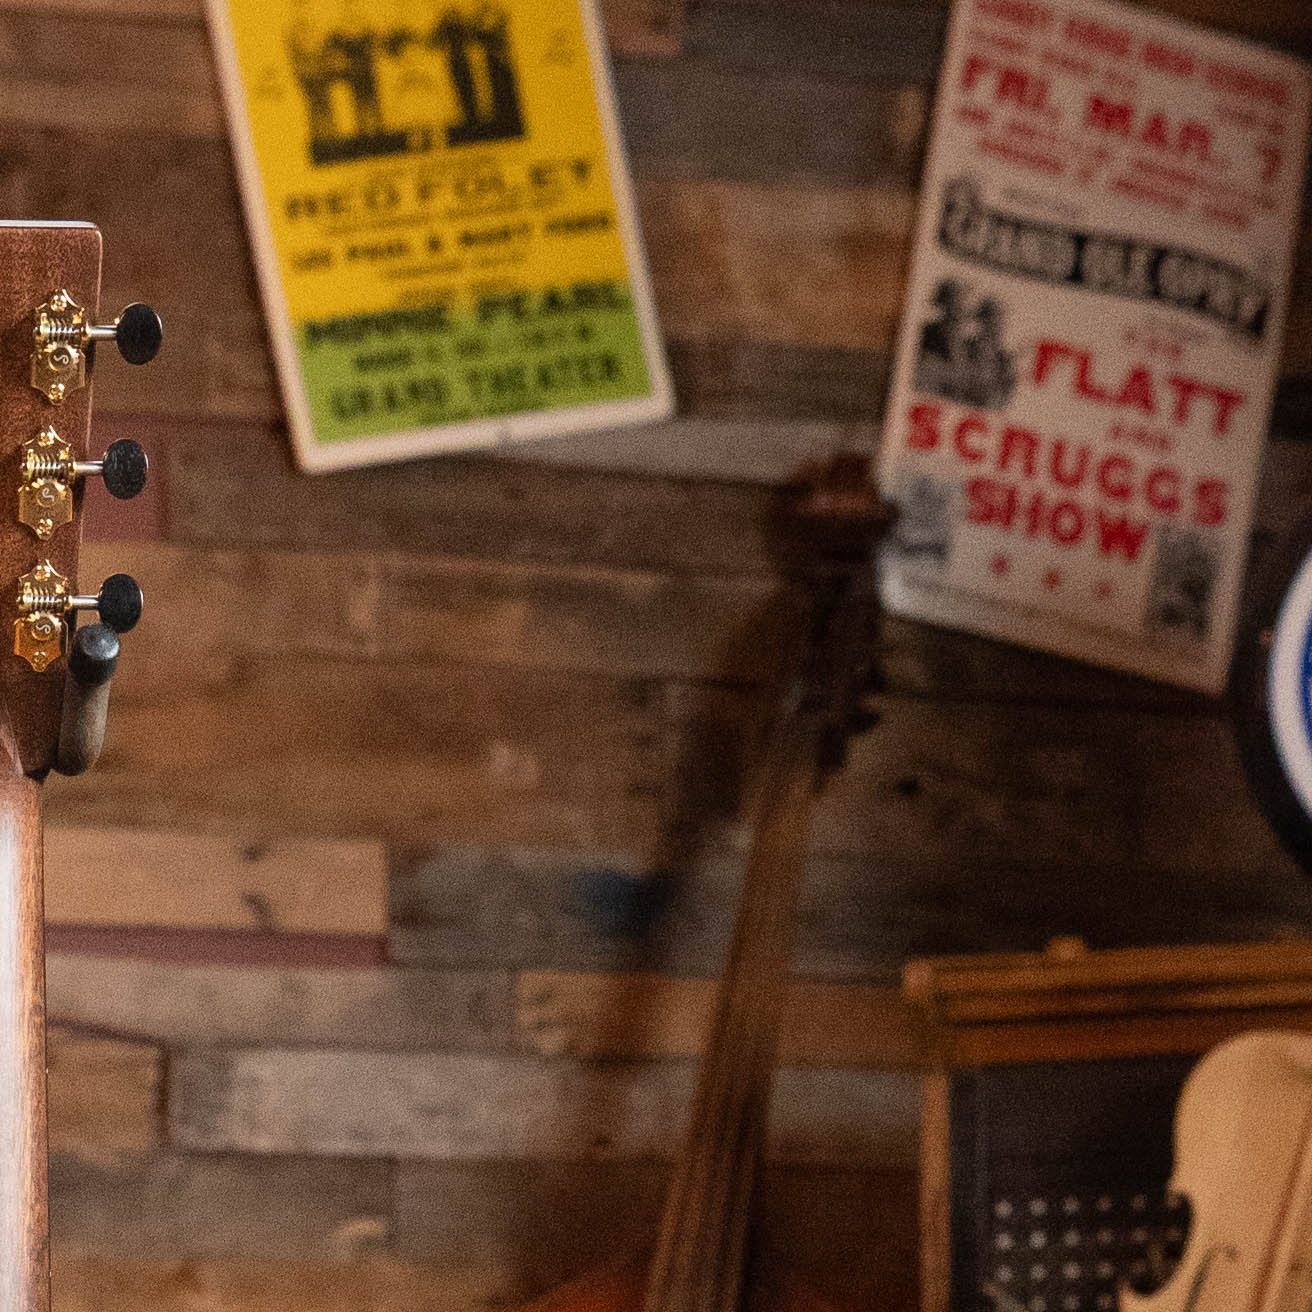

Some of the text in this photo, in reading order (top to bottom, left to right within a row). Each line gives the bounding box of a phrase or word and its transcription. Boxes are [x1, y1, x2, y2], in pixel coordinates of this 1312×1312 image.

[287, 176, 402, 220] RED
[417, 157, 592, 202] FOLEY
[331, 377, 449, 421] GRAND
[1033, 338, 1246, 437] FLATT
[907, 402, 1228, 529] SCRUGGS
[965, 476, 1150, 563] SHOW
